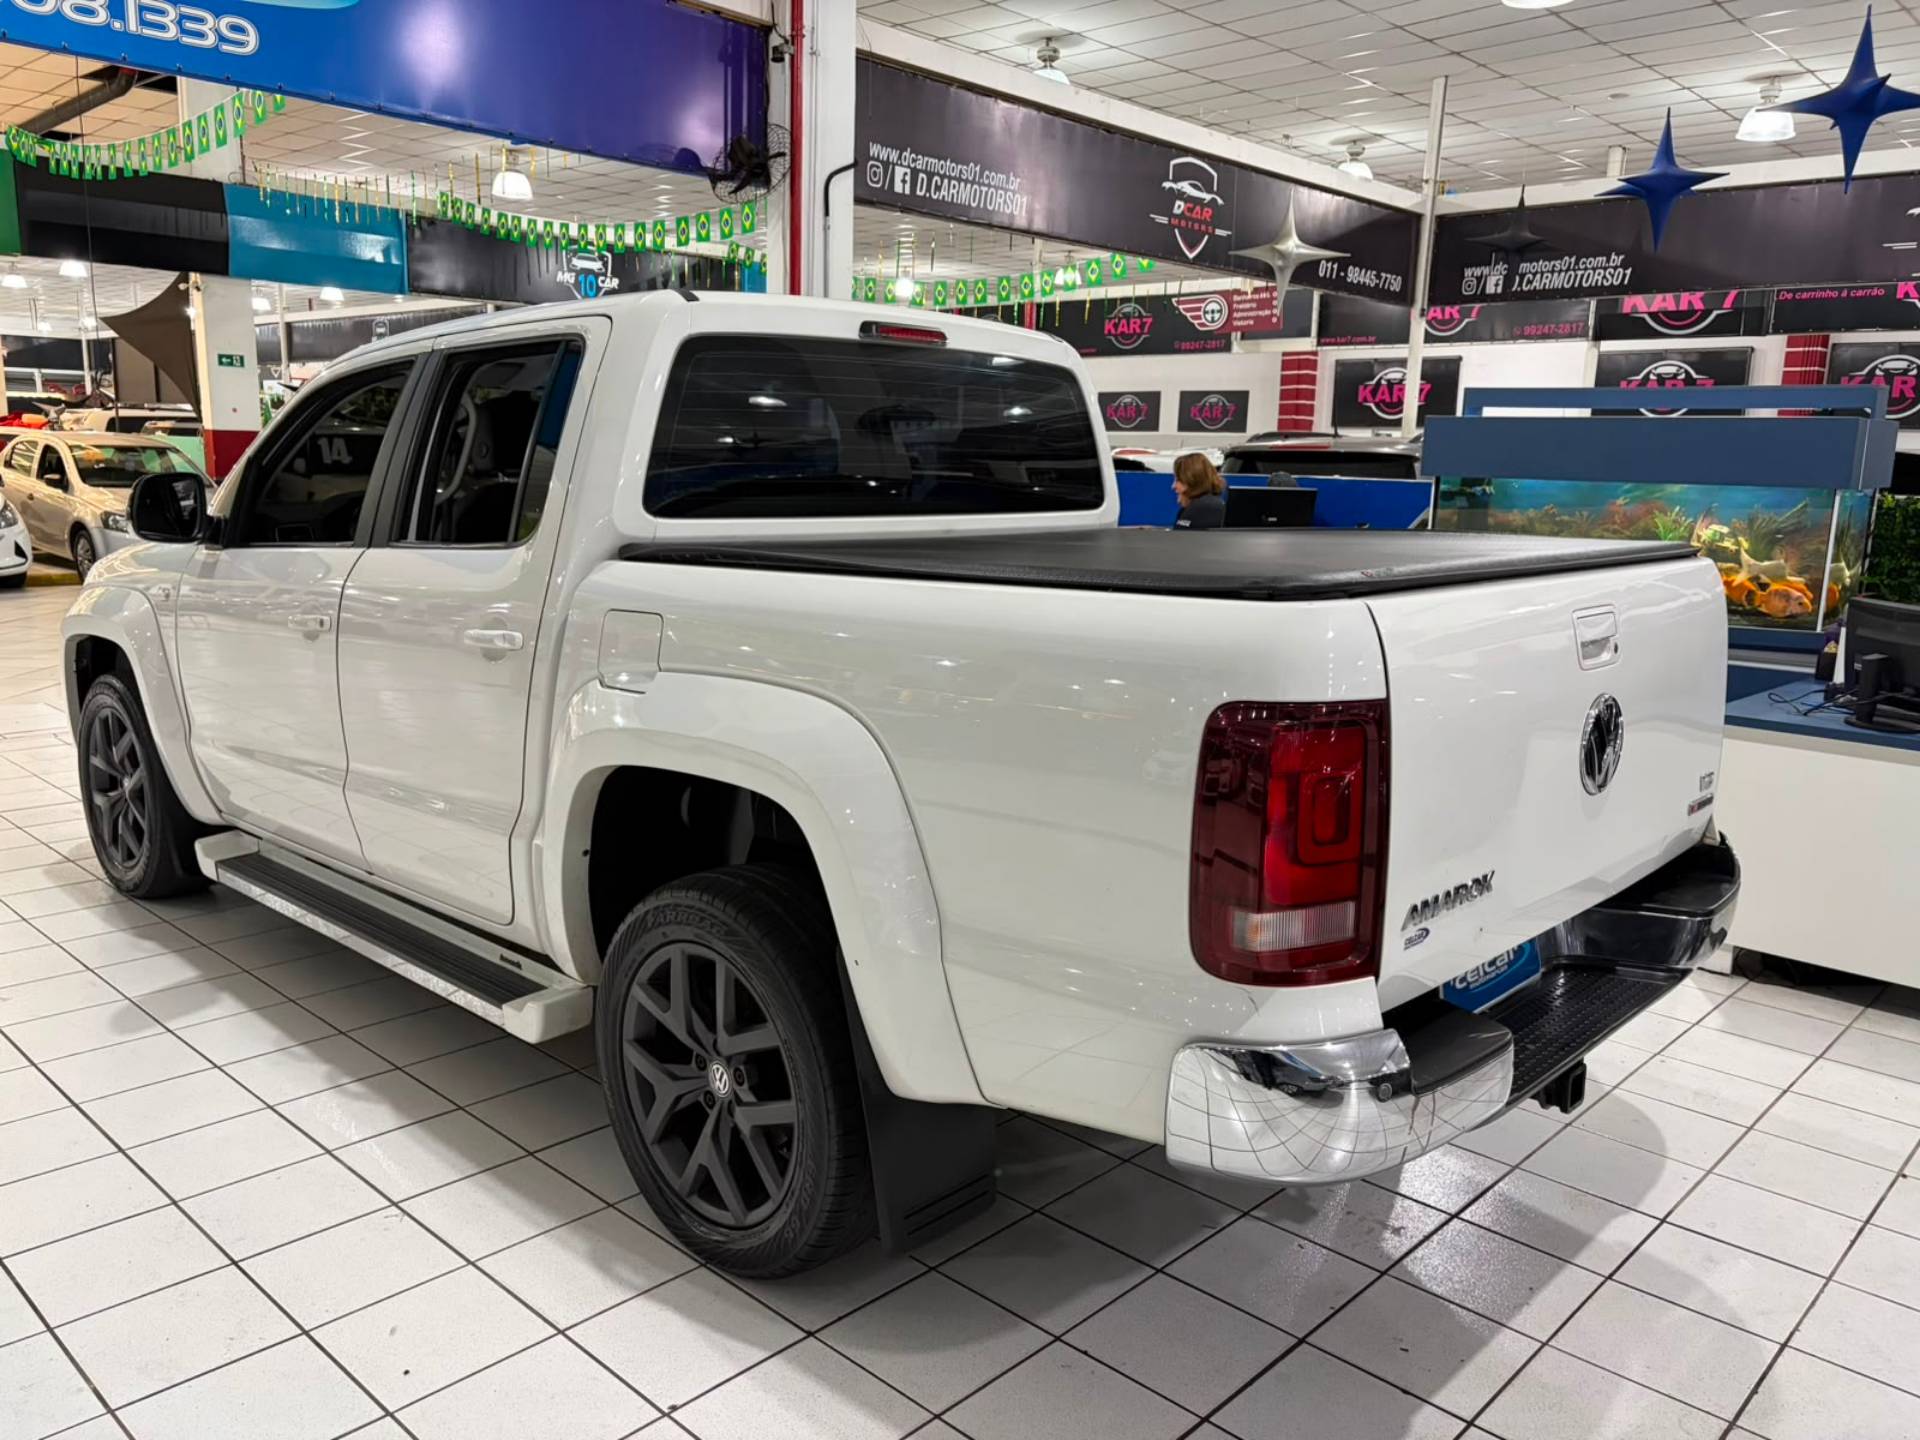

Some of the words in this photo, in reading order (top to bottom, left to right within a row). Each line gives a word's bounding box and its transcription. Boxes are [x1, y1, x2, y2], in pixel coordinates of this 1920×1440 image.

[869, 141, 1021, 191] www.dcarmotors01.com.br
[916, 173, 1028, 216] D.CARMOTORS01
[1172, 199, 1214, 222] DCAR
[557, 271, 576, 284] MG
[578, 273, 596, 298] 10
[598, 276, 619, 289] CAR
[1318, 259, 1338, 279] 011
[1346, 265, 1402, 292] 98445-7750
[1779, 291, 1793, 300] De
[1795, 288, 1839, 299] carrinho
[1850, 287, 1886, 297] carrão
[1106, 404, 1137, 418] KAR
[1190, 404, 1223, 418] KAR
